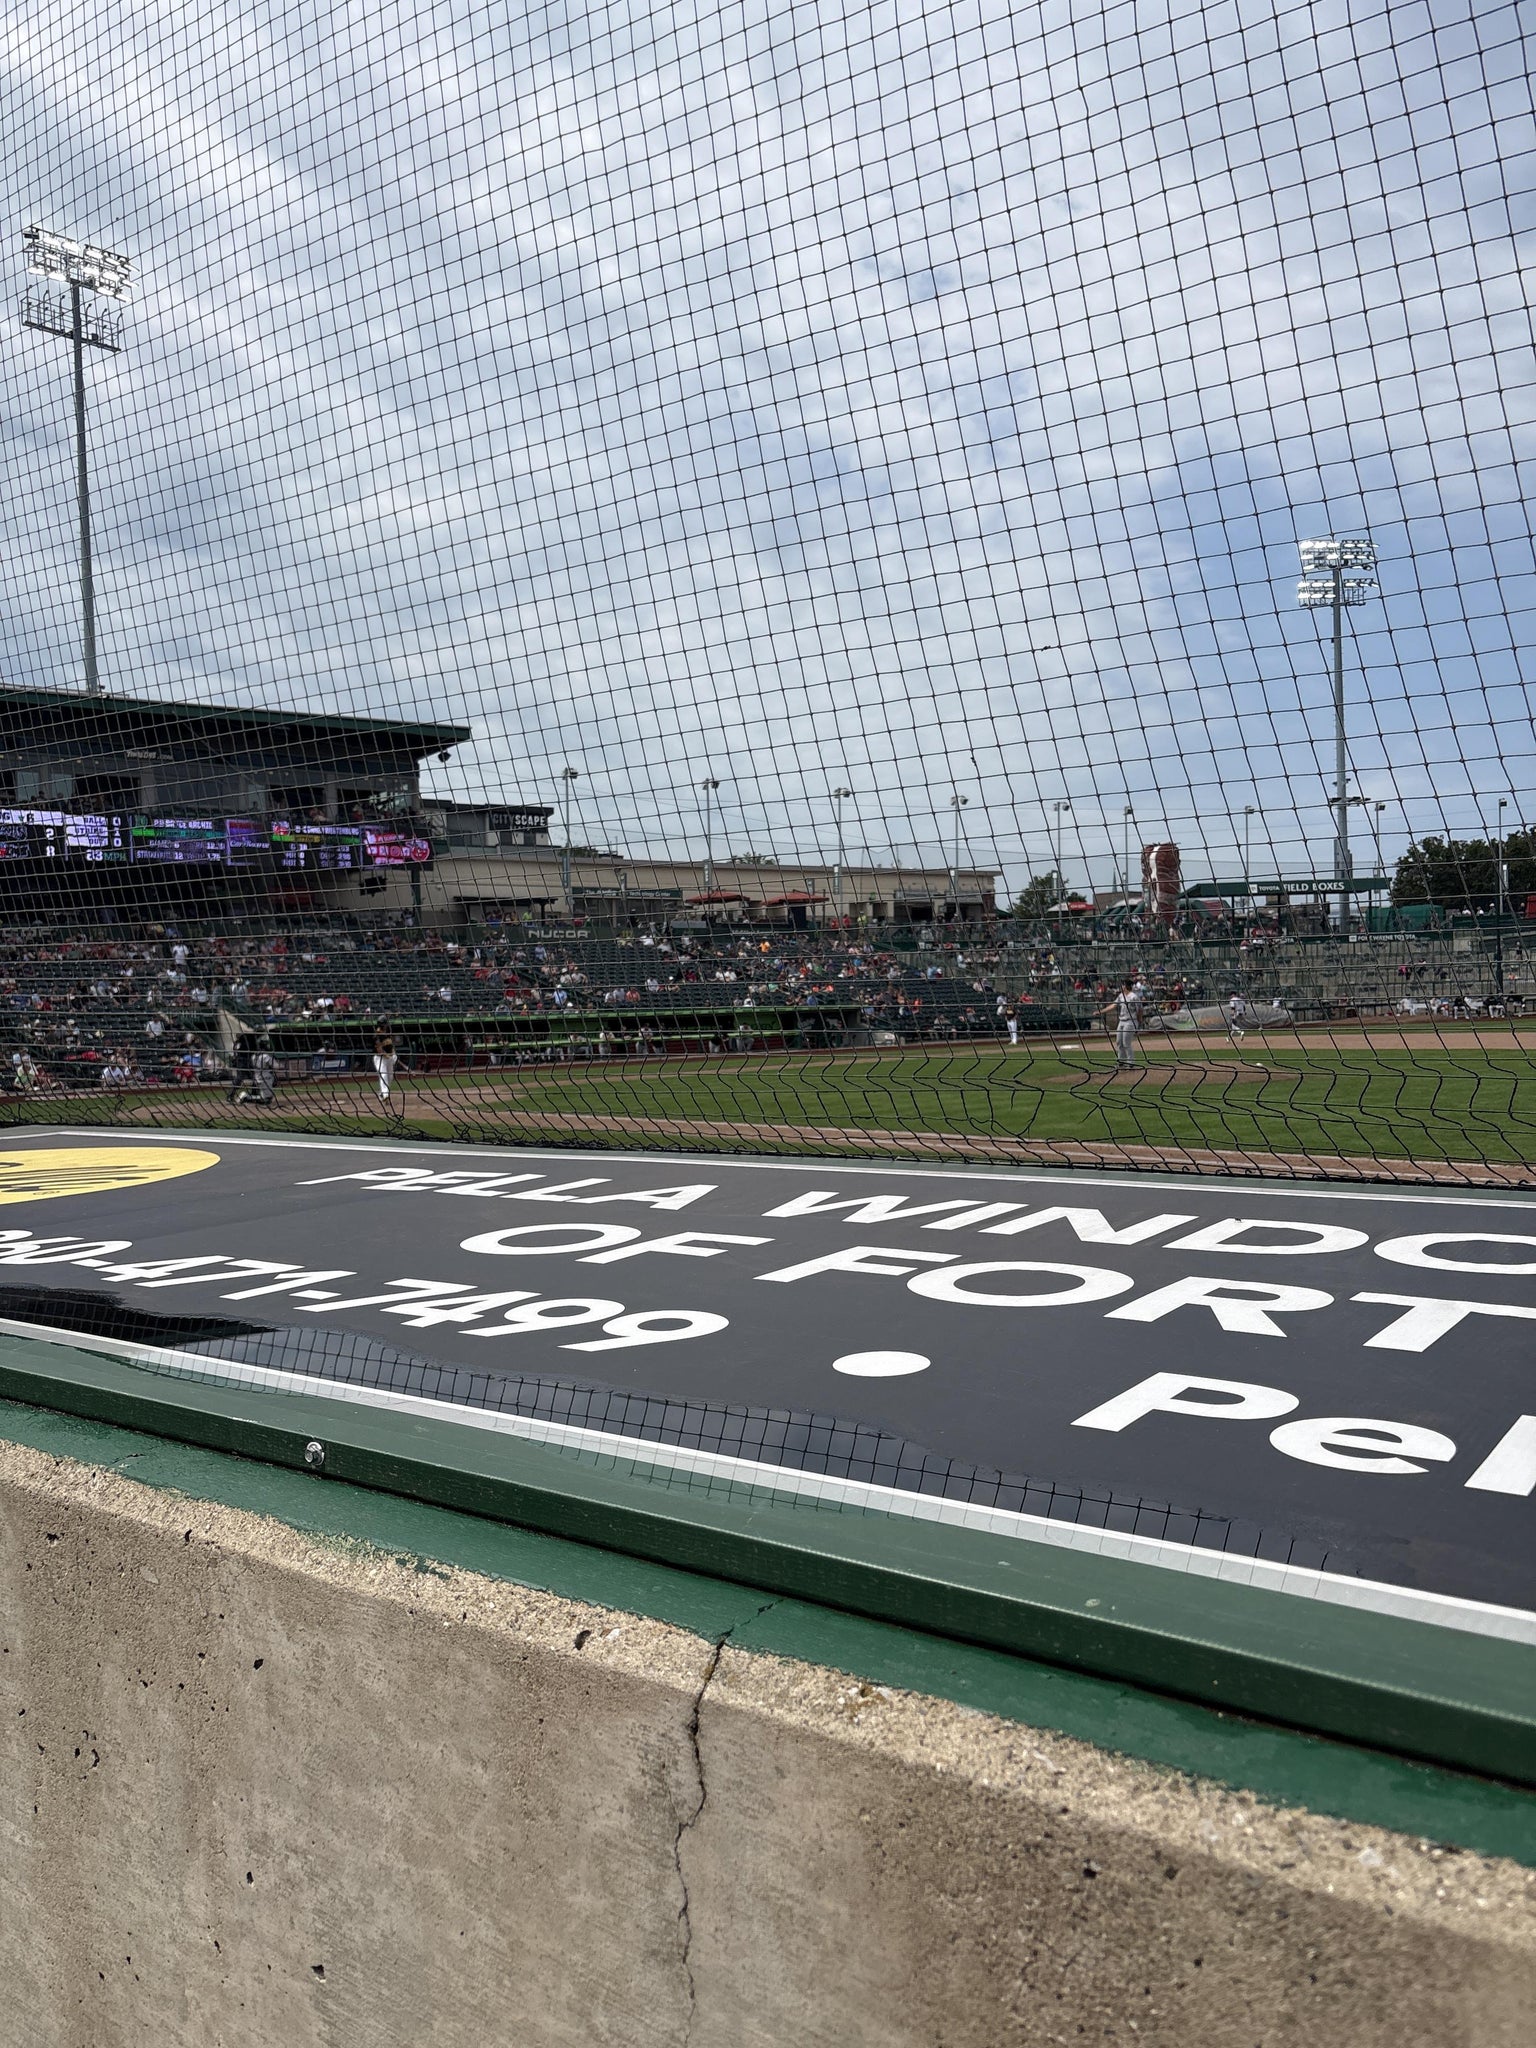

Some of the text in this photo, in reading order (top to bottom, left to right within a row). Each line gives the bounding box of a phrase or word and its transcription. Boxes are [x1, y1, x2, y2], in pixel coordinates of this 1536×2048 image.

[493, 812, 546, 826] CITYSCAPE
[45, 827, 55, 841] 2
[113, 837, 122, 847] 0
[104, 851, 127, 862] MPH
[1283, 883, 1309, 892] FIELD
[1312, 882, 1345, 891] BOXES
[528, 929, 590, 939] NUCOR
[296, 1167, 719, 1211] PELLA
[0, 1229, 730, 1352] 60-471-7499
[460, 1223, 1536, 1353] OF FORT
